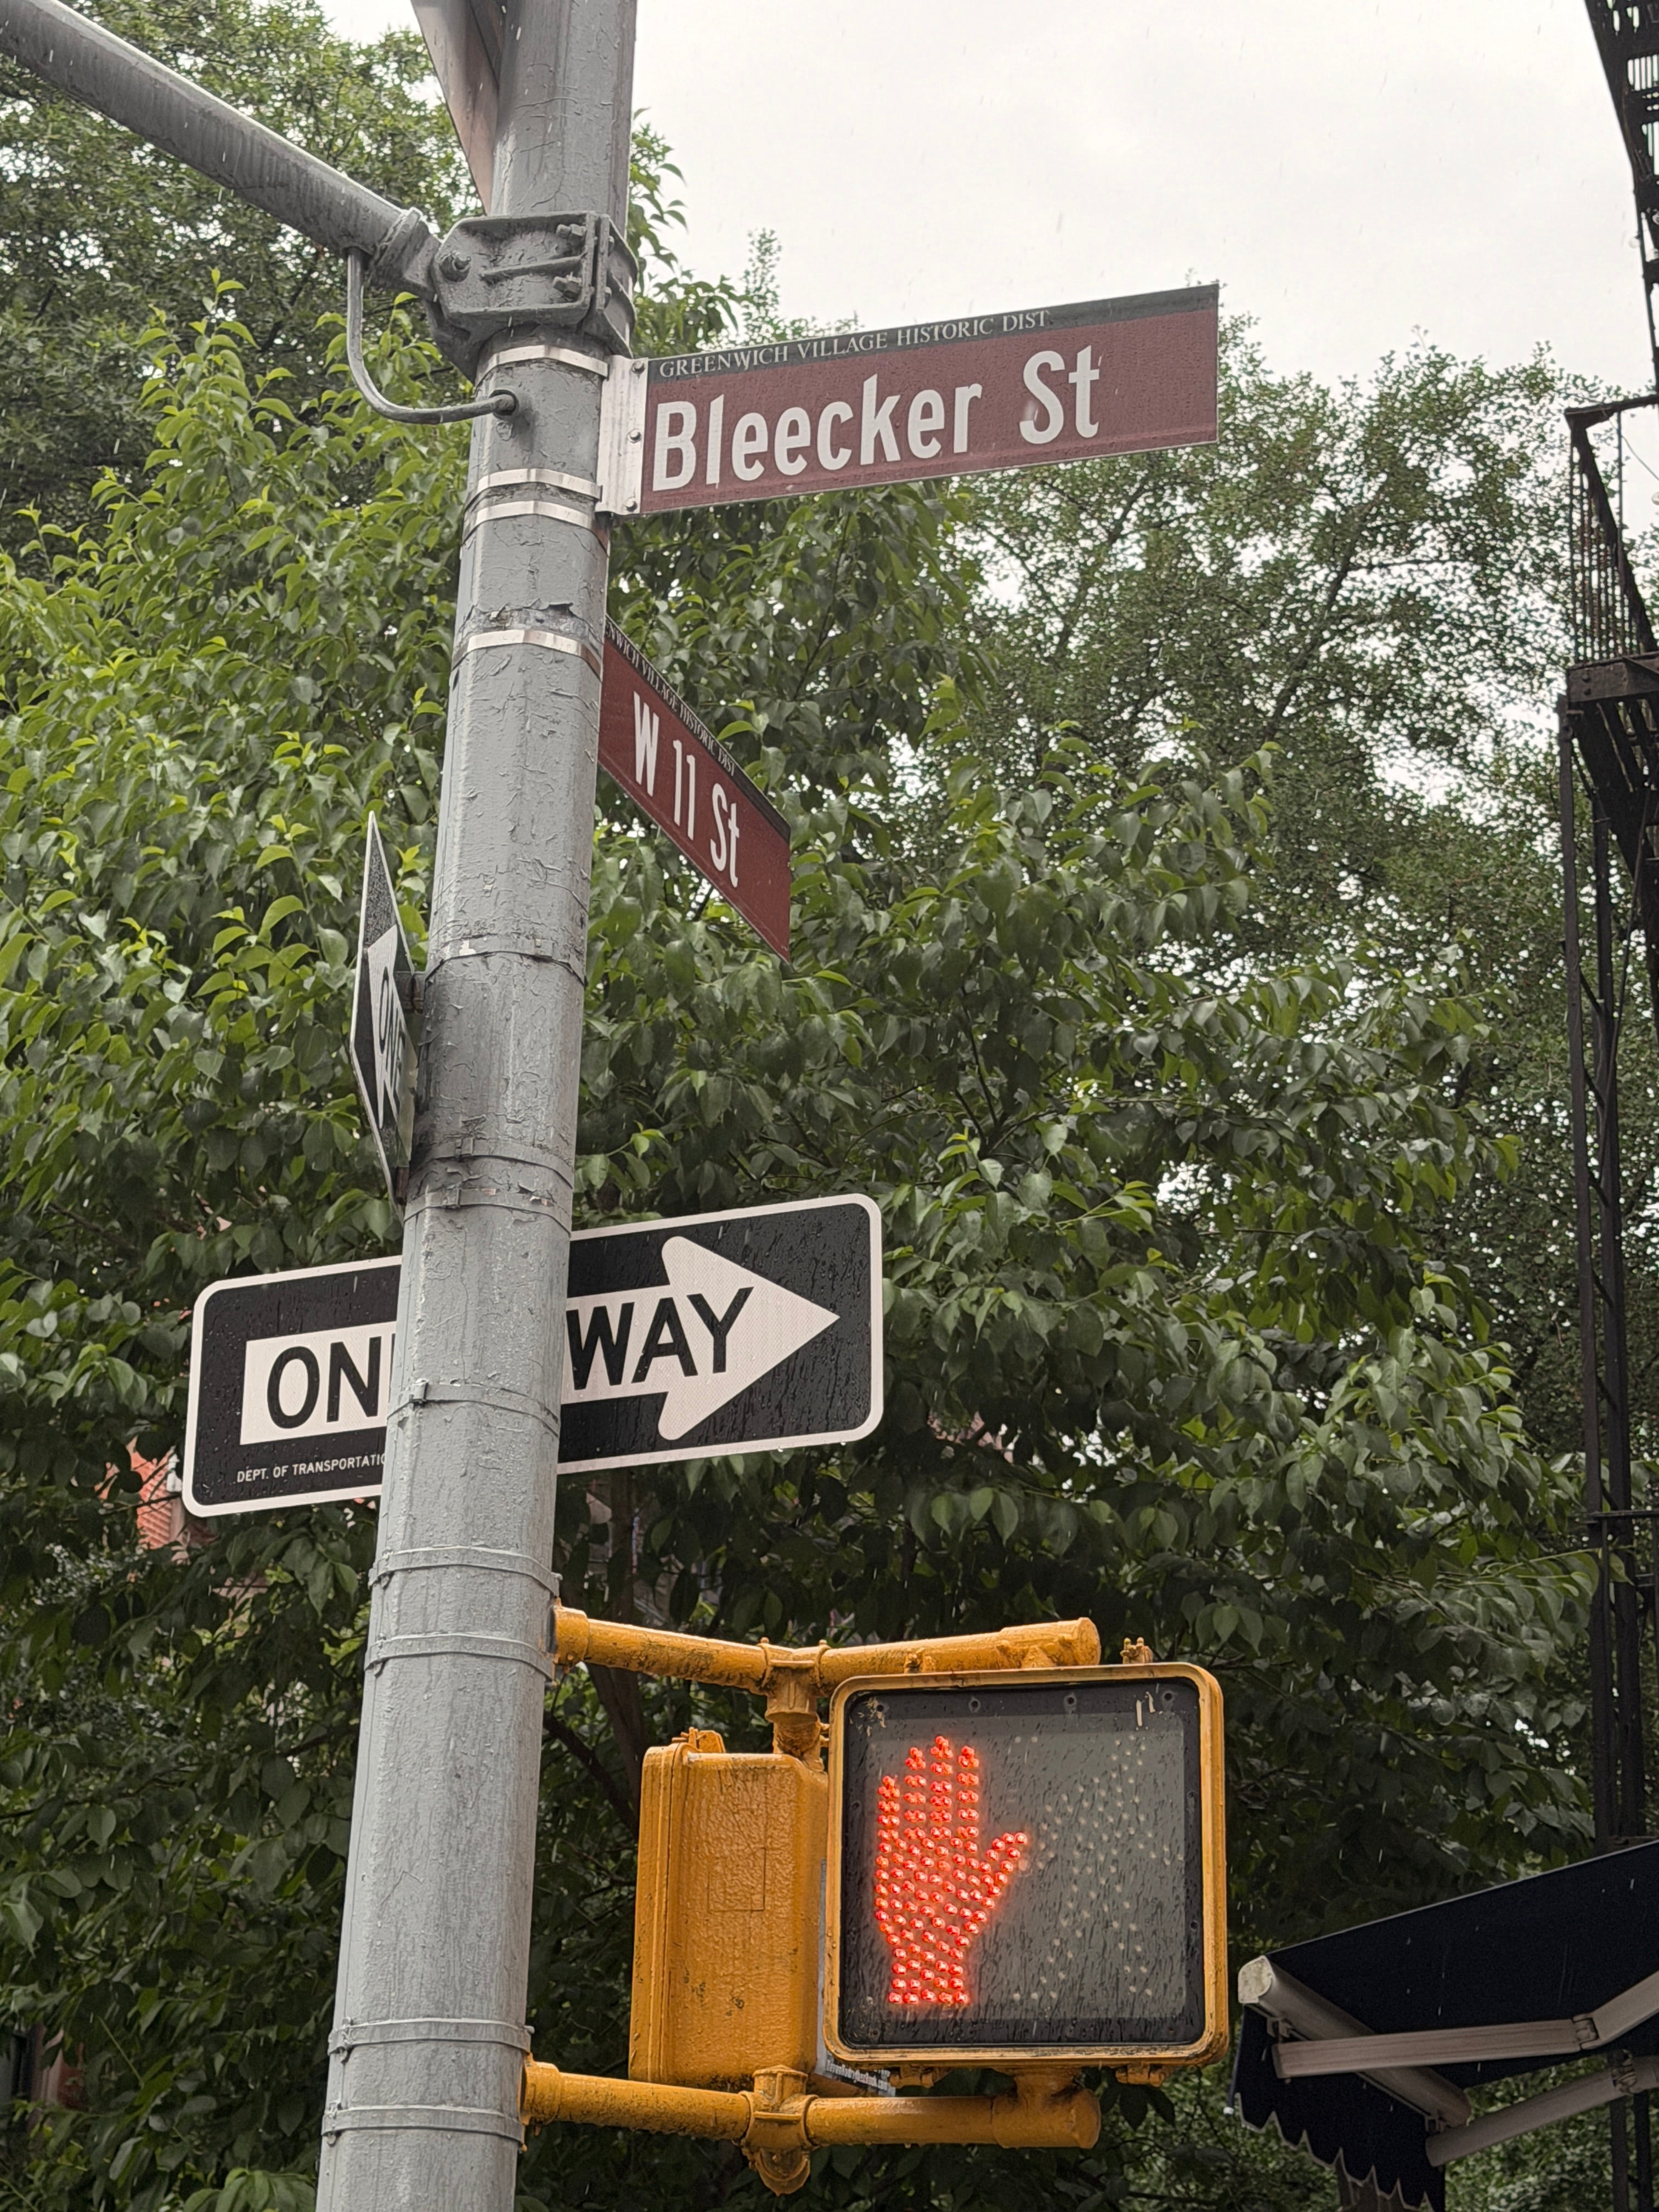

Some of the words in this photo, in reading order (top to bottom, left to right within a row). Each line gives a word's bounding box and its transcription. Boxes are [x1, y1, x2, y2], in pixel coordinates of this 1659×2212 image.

[659, 346, 788, 377] GREENWICH
[797, 332, 888, 359] VILLAGE
[897, 318, 994, 346] HISTORIC
[1003, 310, 1050, 332] DIST
[652, 373, 983, 492] Bleecker
[1019, 345, 1101, 445] St
[606, 620, 639, 668] NWICH
[642, 659, 678, 712] VILLAGE
[680, 704, 716, 755] HISTORIC
[718, 747, 736, 776] DIST
[634, 691, 659, 797] W
[673, 740, 696, 841] 11
[710, 783, 740, 888] St
[267, 1333, 396, 1429] ON
[566, 1286, 754, 1391] WAY
[237, 1468, 269, 1483] DEPT.
[273, 1465, 289, 1478] OF
